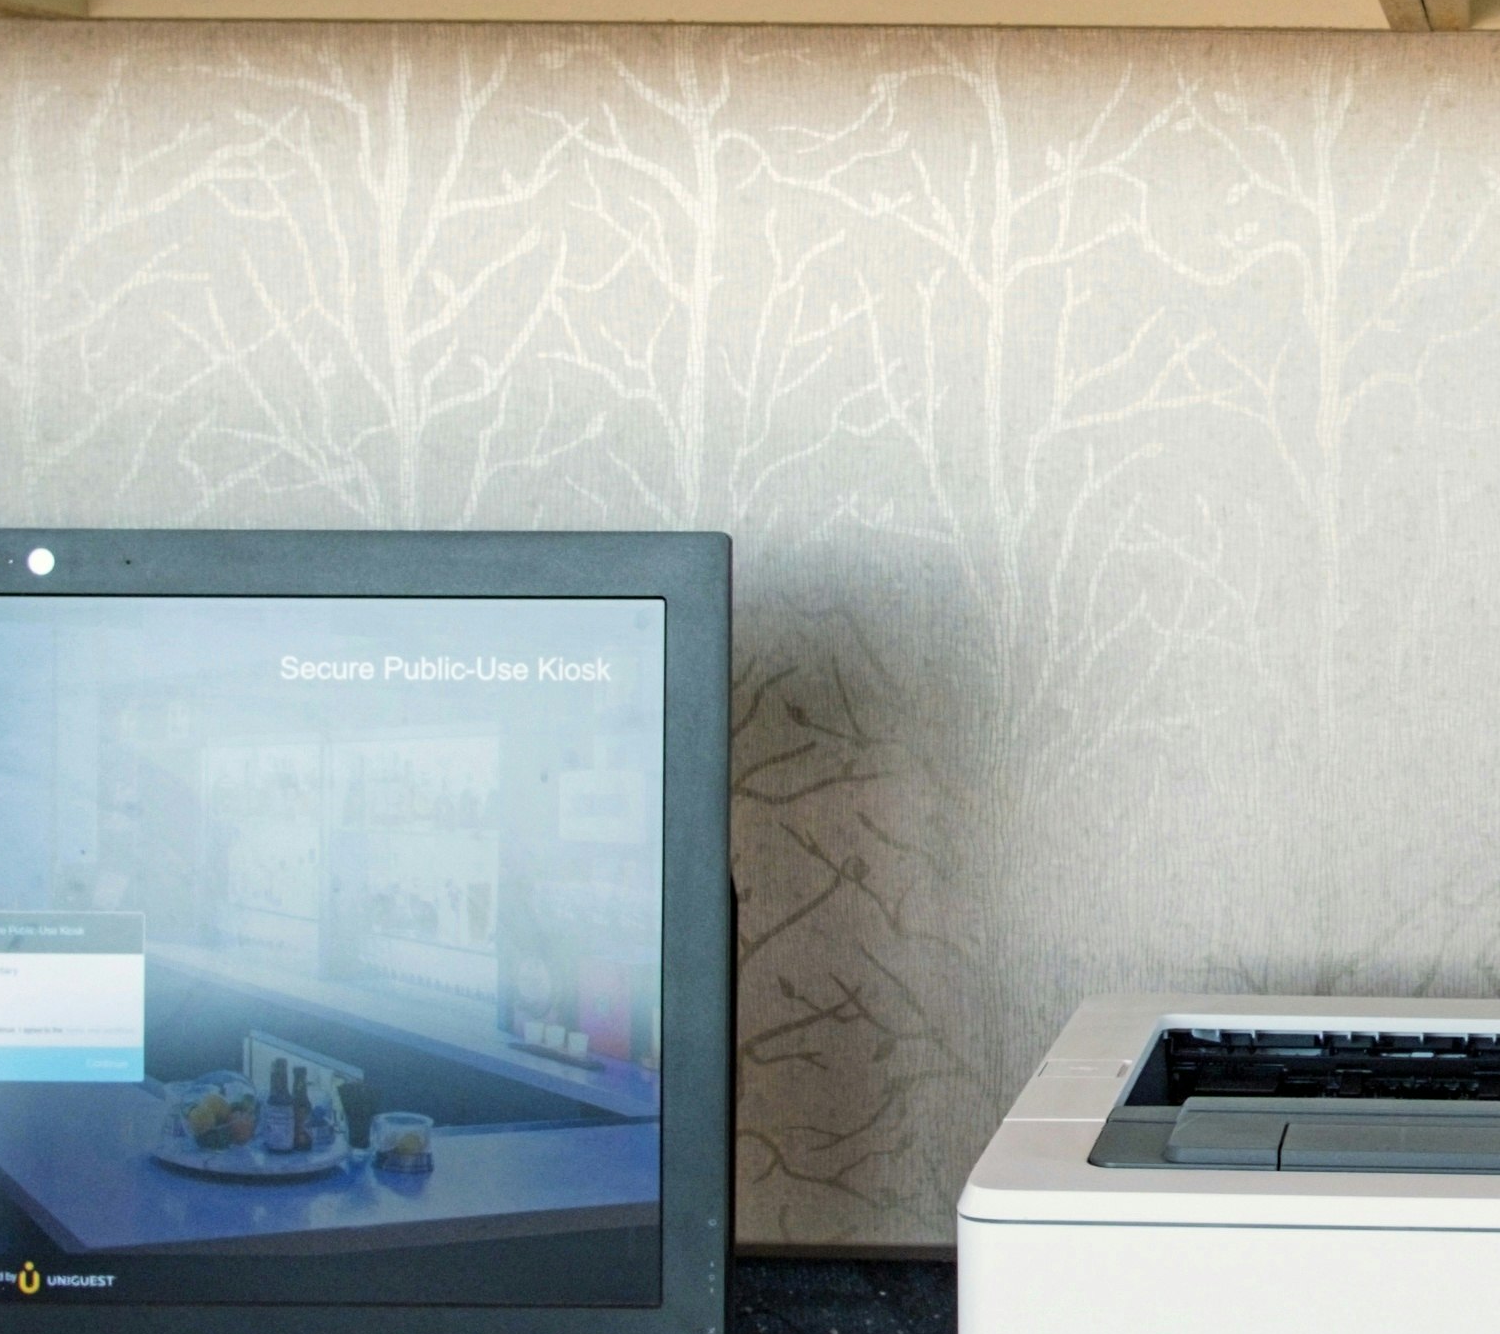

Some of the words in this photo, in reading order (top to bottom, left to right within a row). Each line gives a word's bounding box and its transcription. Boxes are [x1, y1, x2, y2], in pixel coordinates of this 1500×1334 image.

[280, 655, 375, 681] Secure
[383, 655, 529, 682] Public-Use
[538, 656, 612, 682] Kiosk
[4, 1271, 18, 1284] by
[46, 1275, 115, 1287] UNIGUEST
